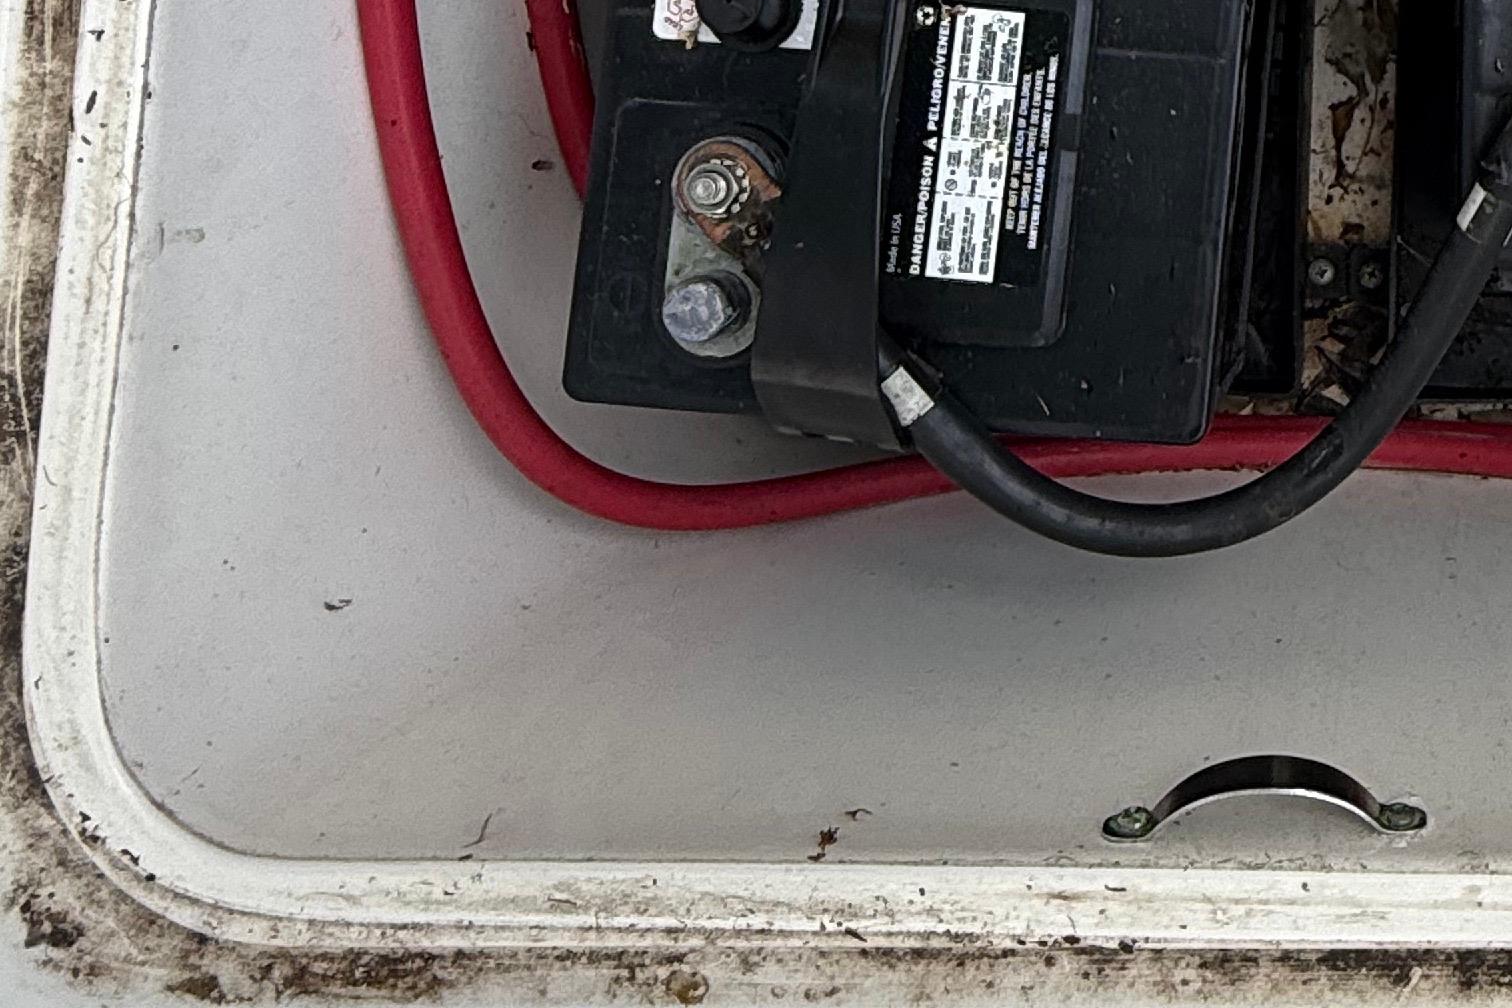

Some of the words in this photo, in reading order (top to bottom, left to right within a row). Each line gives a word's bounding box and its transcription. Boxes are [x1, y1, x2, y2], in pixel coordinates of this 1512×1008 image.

[891, 213, 903, 233] USA
[909, 155, 935, 276] DANGER/POISON
[889, 235, 900, 245] in
[886, 246, 899, 273] Made
